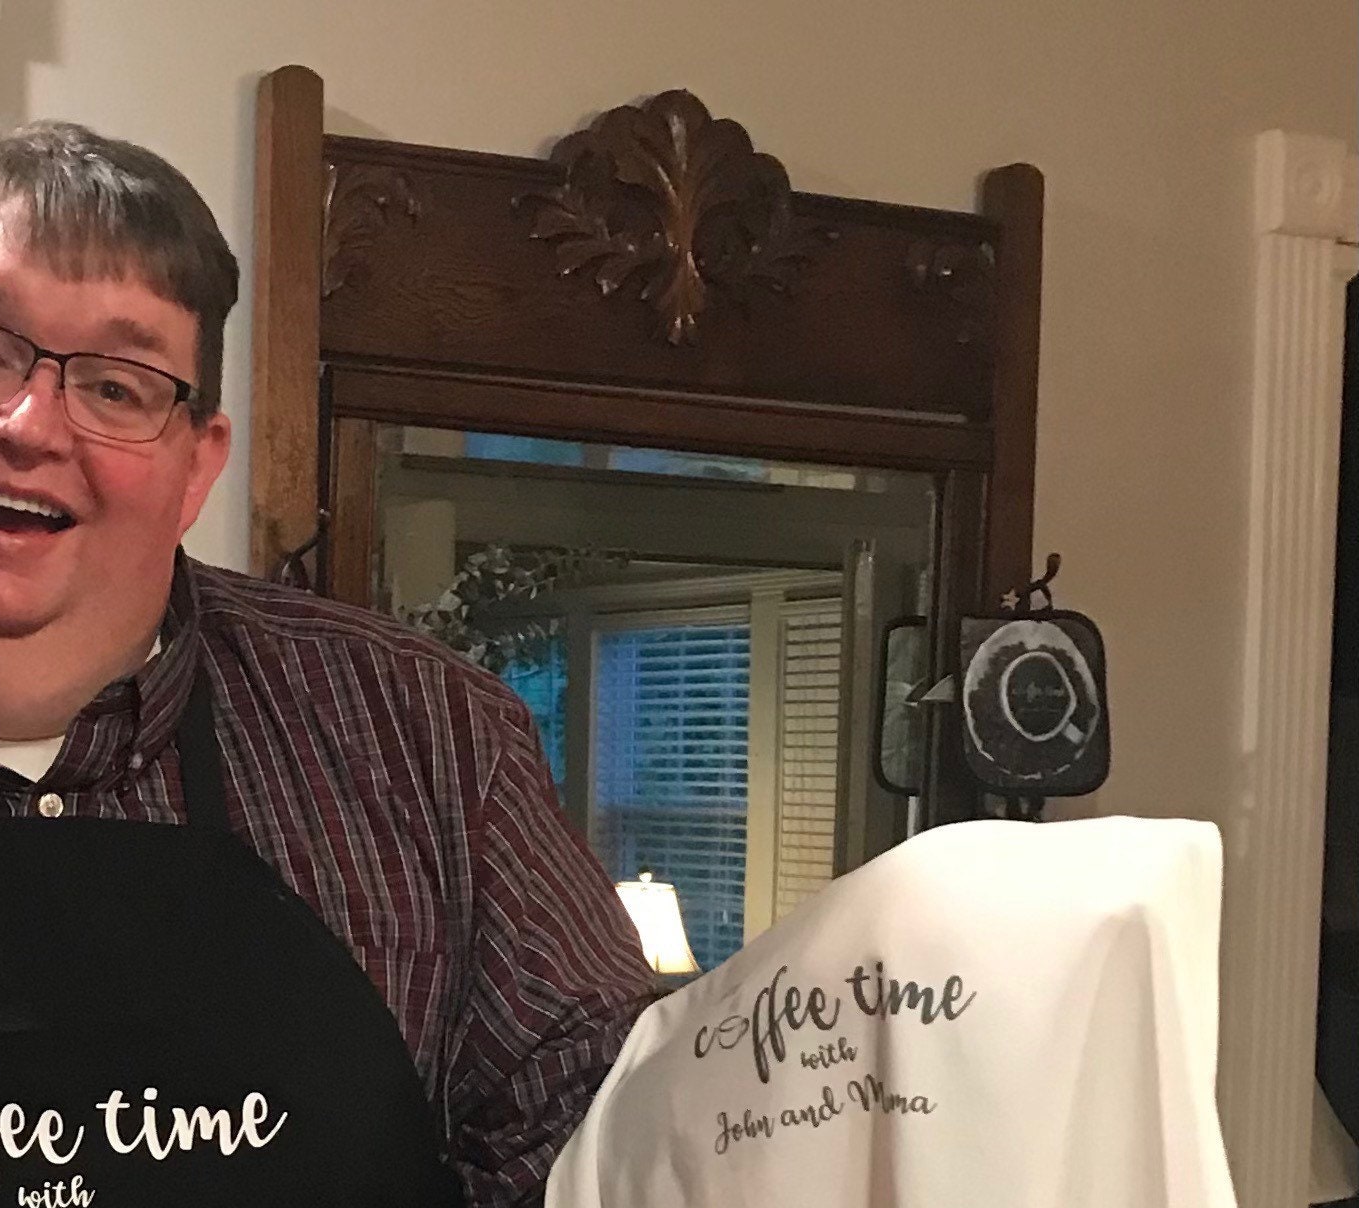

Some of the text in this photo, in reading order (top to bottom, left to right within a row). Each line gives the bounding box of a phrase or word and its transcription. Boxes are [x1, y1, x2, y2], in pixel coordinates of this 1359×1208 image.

[844, 960, 977, 1025] time
[799, 1036, 858, 1070] with
[95, 1087, 288, 1160] time
[714, 1109, 776, 1155] John
[780, 1085, 845, 1128] and
